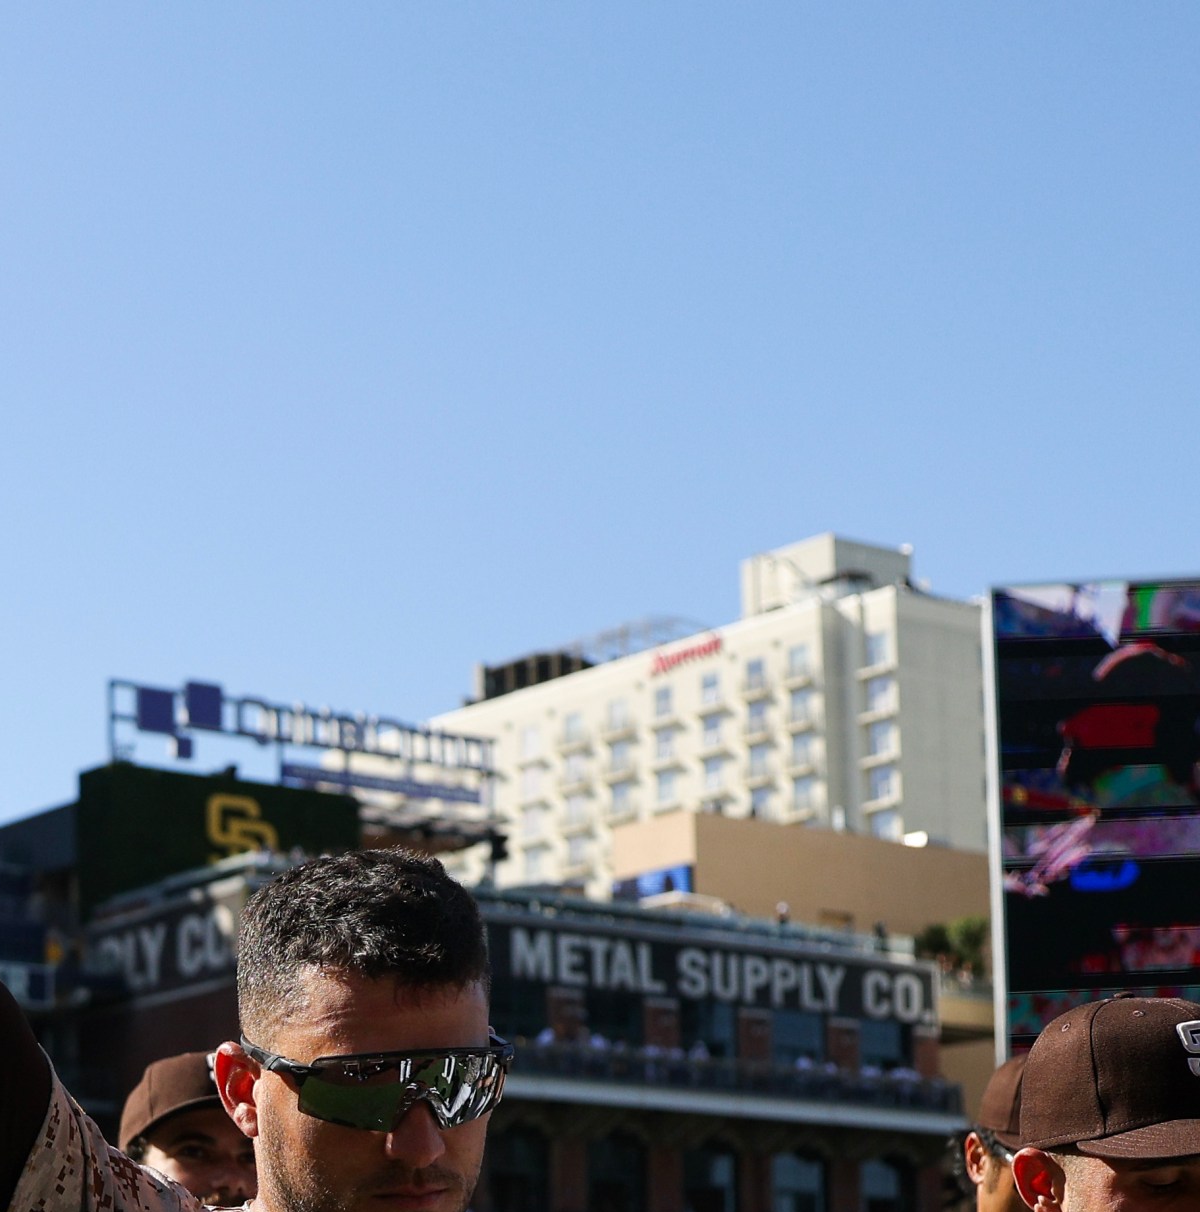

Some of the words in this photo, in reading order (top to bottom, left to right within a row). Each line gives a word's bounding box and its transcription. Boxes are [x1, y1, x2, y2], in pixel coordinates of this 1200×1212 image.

[510, 926, 667, 995] METAL
[676, 948, 846, 1012] SUPPLY
[861, 969, 938, 1026] CO.
